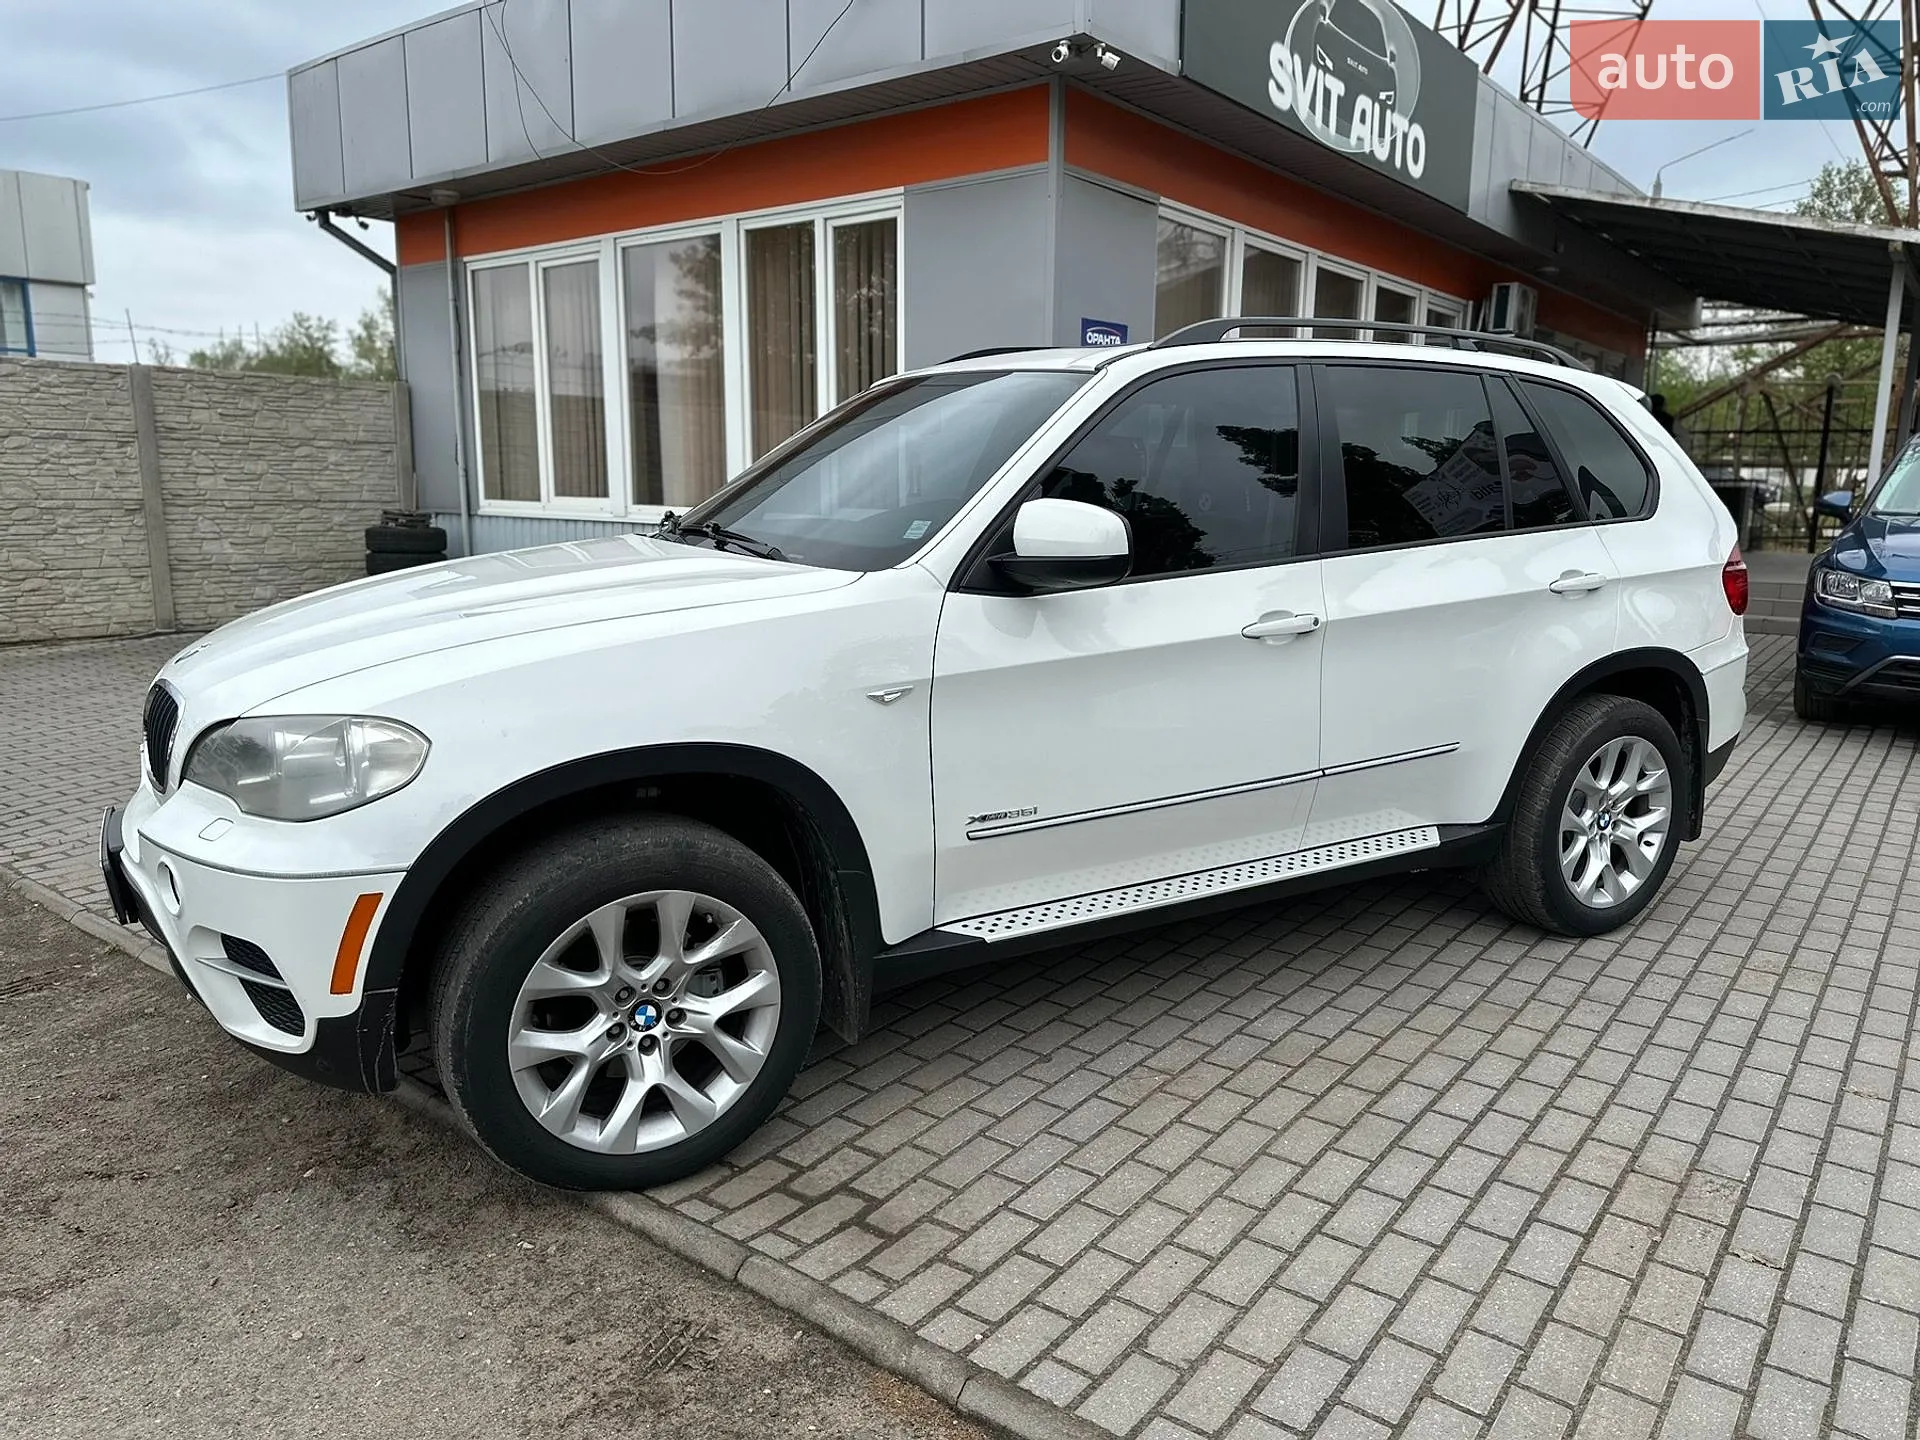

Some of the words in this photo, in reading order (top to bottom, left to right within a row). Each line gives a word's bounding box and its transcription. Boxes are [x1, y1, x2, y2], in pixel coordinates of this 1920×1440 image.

[1268, 41, 1346, 136] SVIT
[1350, 94, 1426, 179] AUTO
[1086, 331, 1121, 345] ОРАНТА
